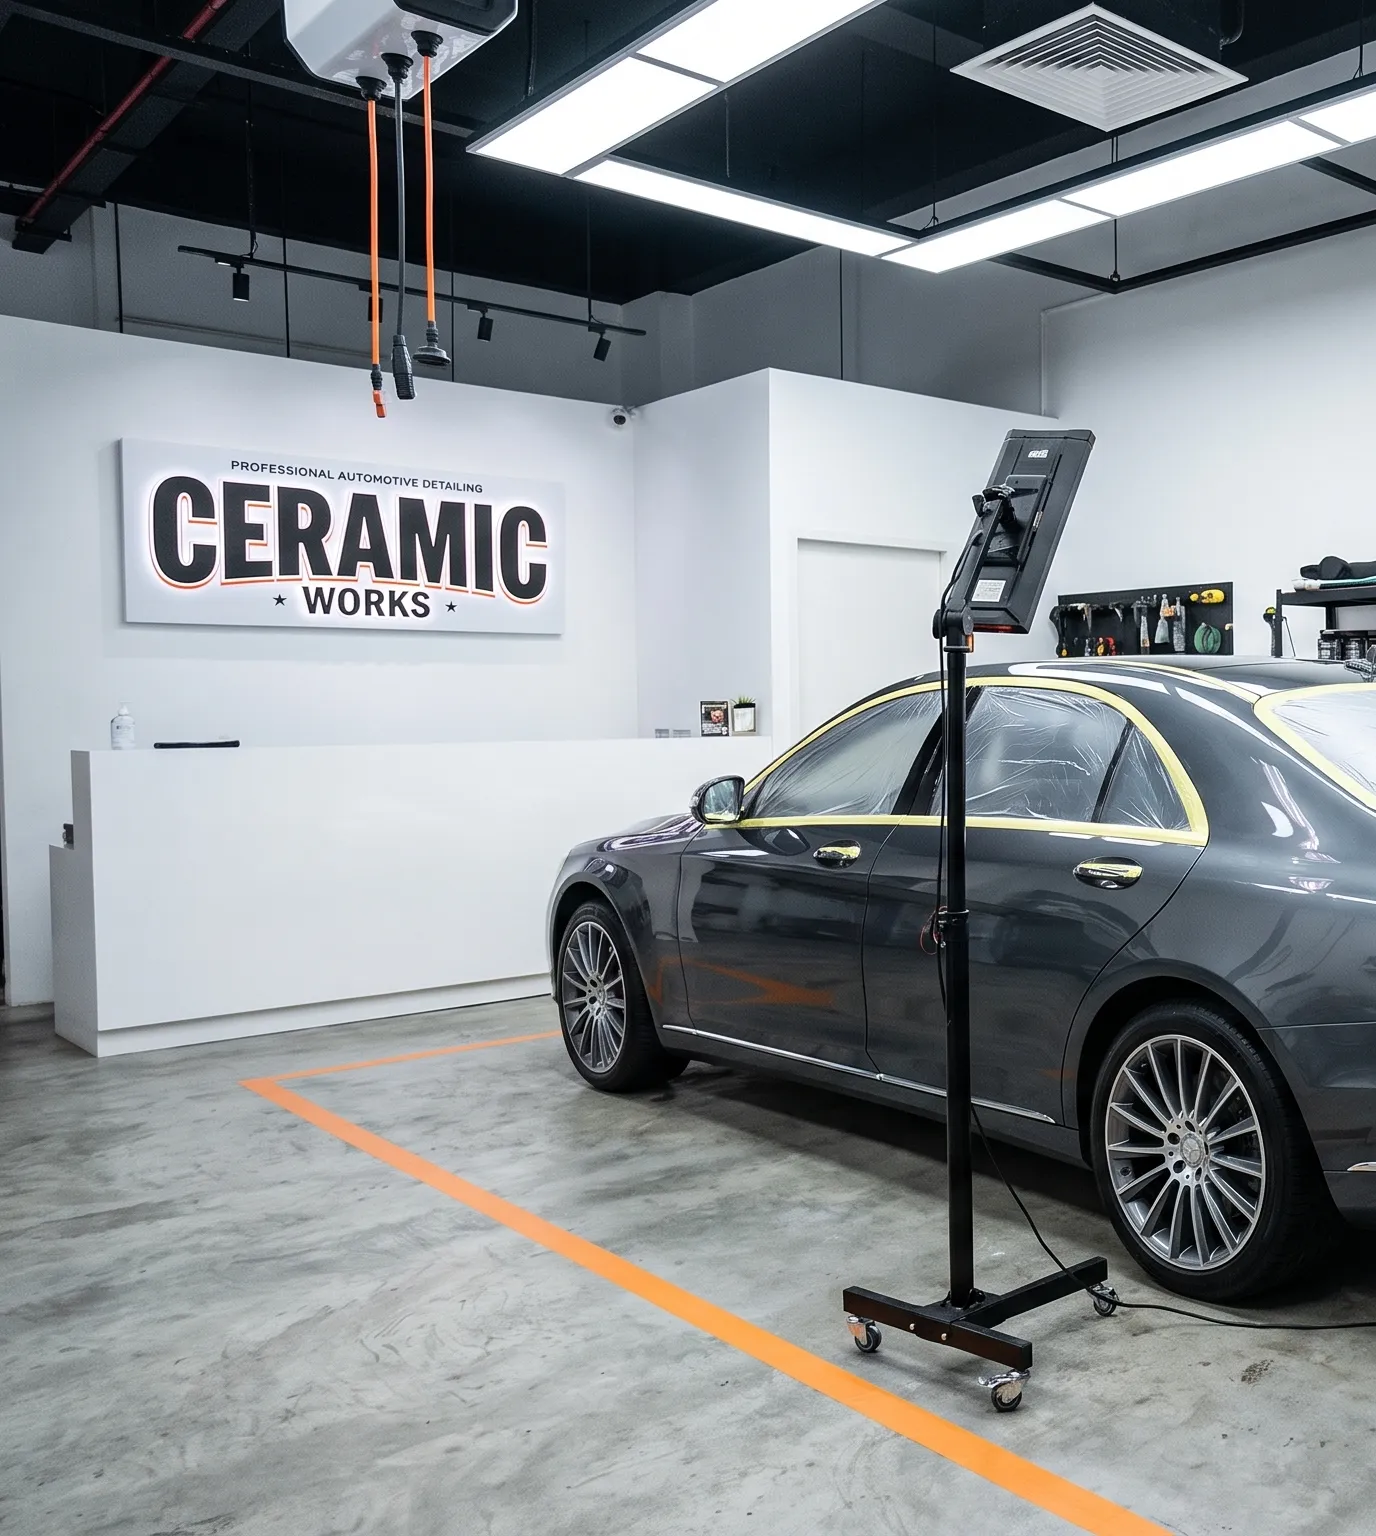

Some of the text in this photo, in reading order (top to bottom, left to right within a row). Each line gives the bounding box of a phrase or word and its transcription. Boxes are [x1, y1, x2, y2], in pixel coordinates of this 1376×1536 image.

[231, 460, 483, 494] PROFESSIONAL AUTOMOTIVE DETAILING
[152, 476, 548, 600] CERAMIC
[302, 586, 431, 619] WORKS
